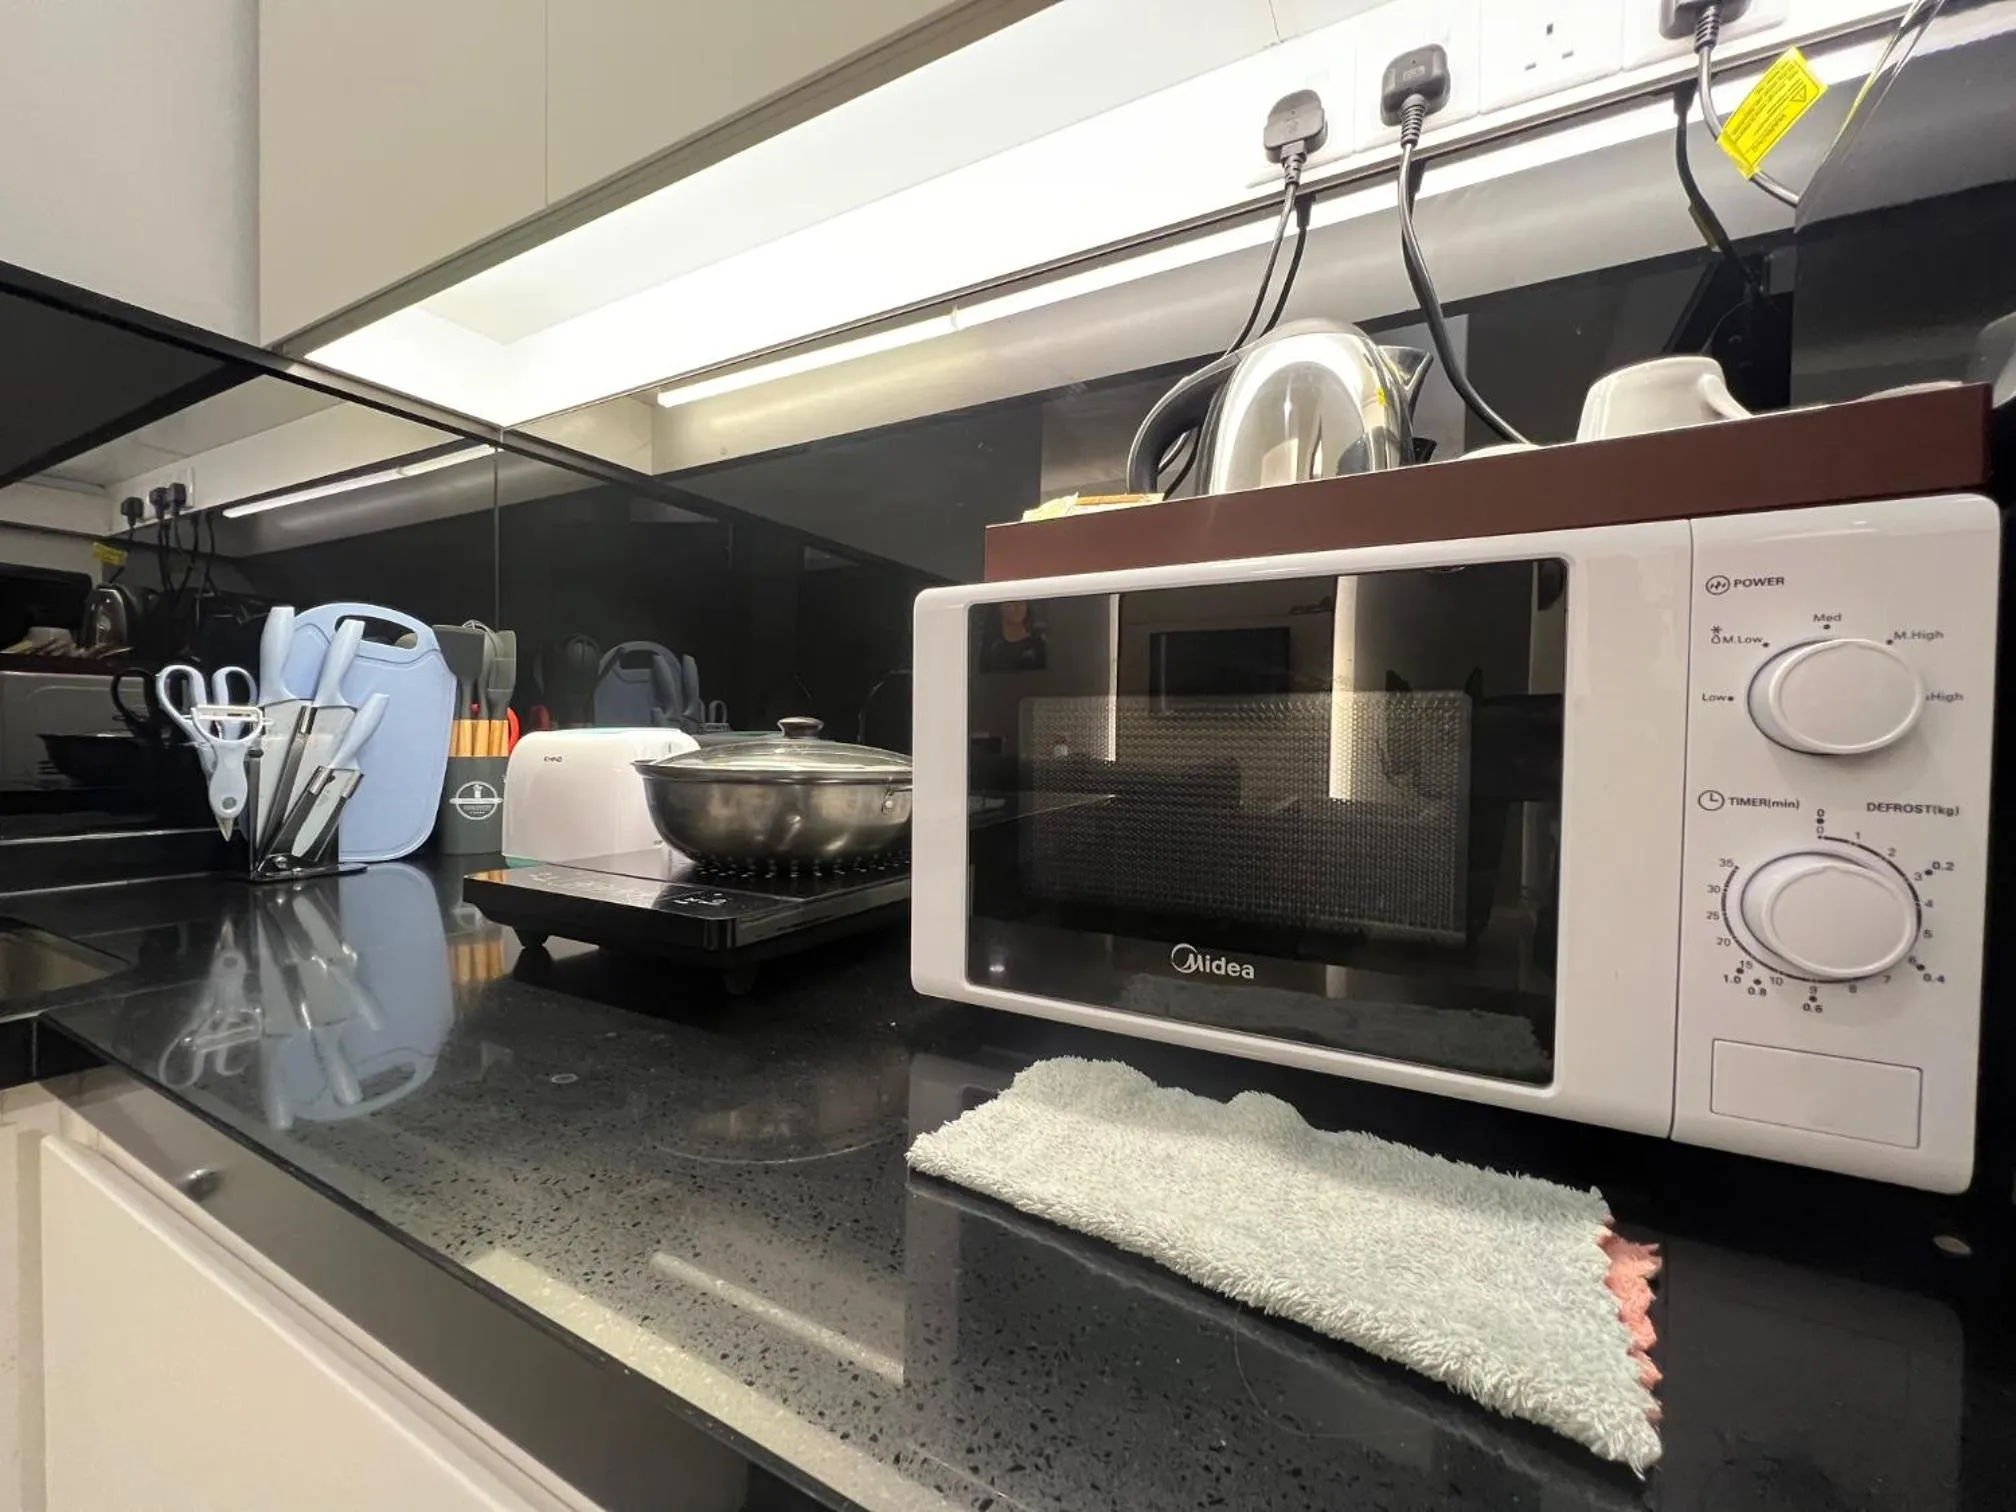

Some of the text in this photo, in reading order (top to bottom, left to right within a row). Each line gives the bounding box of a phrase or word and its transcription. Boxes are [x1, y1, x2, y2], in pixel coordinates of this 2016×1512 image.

[1734, 576, 1784, 588] POWER
[1813, 613, 1842, 622] Med
[1893, 630, 1944, 640] M.High
[1722, 636, 1763, 644] M.Low
[1702, 694, 1726, 702] Low
[1930, 692, 1964, 702] High
[1728, 797, 1800, 809] TIMER(min)
[1817, 808, 1824, 818] 0
[1866, 802, 1959, 817] DEFROST(kg)
[1855, 832, 1860, 840] 1
[1888, 848, 1896, 857] 2
[1720, 858, 1734, 868] 35
[1932, 861, 1954, 871] 0.2
[1914, 872, 1922, 881] 3
[1707, 884, 1720, 893] 30
[1706, 912, 1720, 920] 25
[1716, 938, 1731, 946] 20
[1171, 943, 1255, 980] Midea
[1740, 960, 1753, 969] 15
[1724, 975, 1741, 984] 1.0
[1770, 976, 1783, 986] 10
[1883, 975, 1892, 984] 7
[1923, 974, 1944, 983] 0.4
